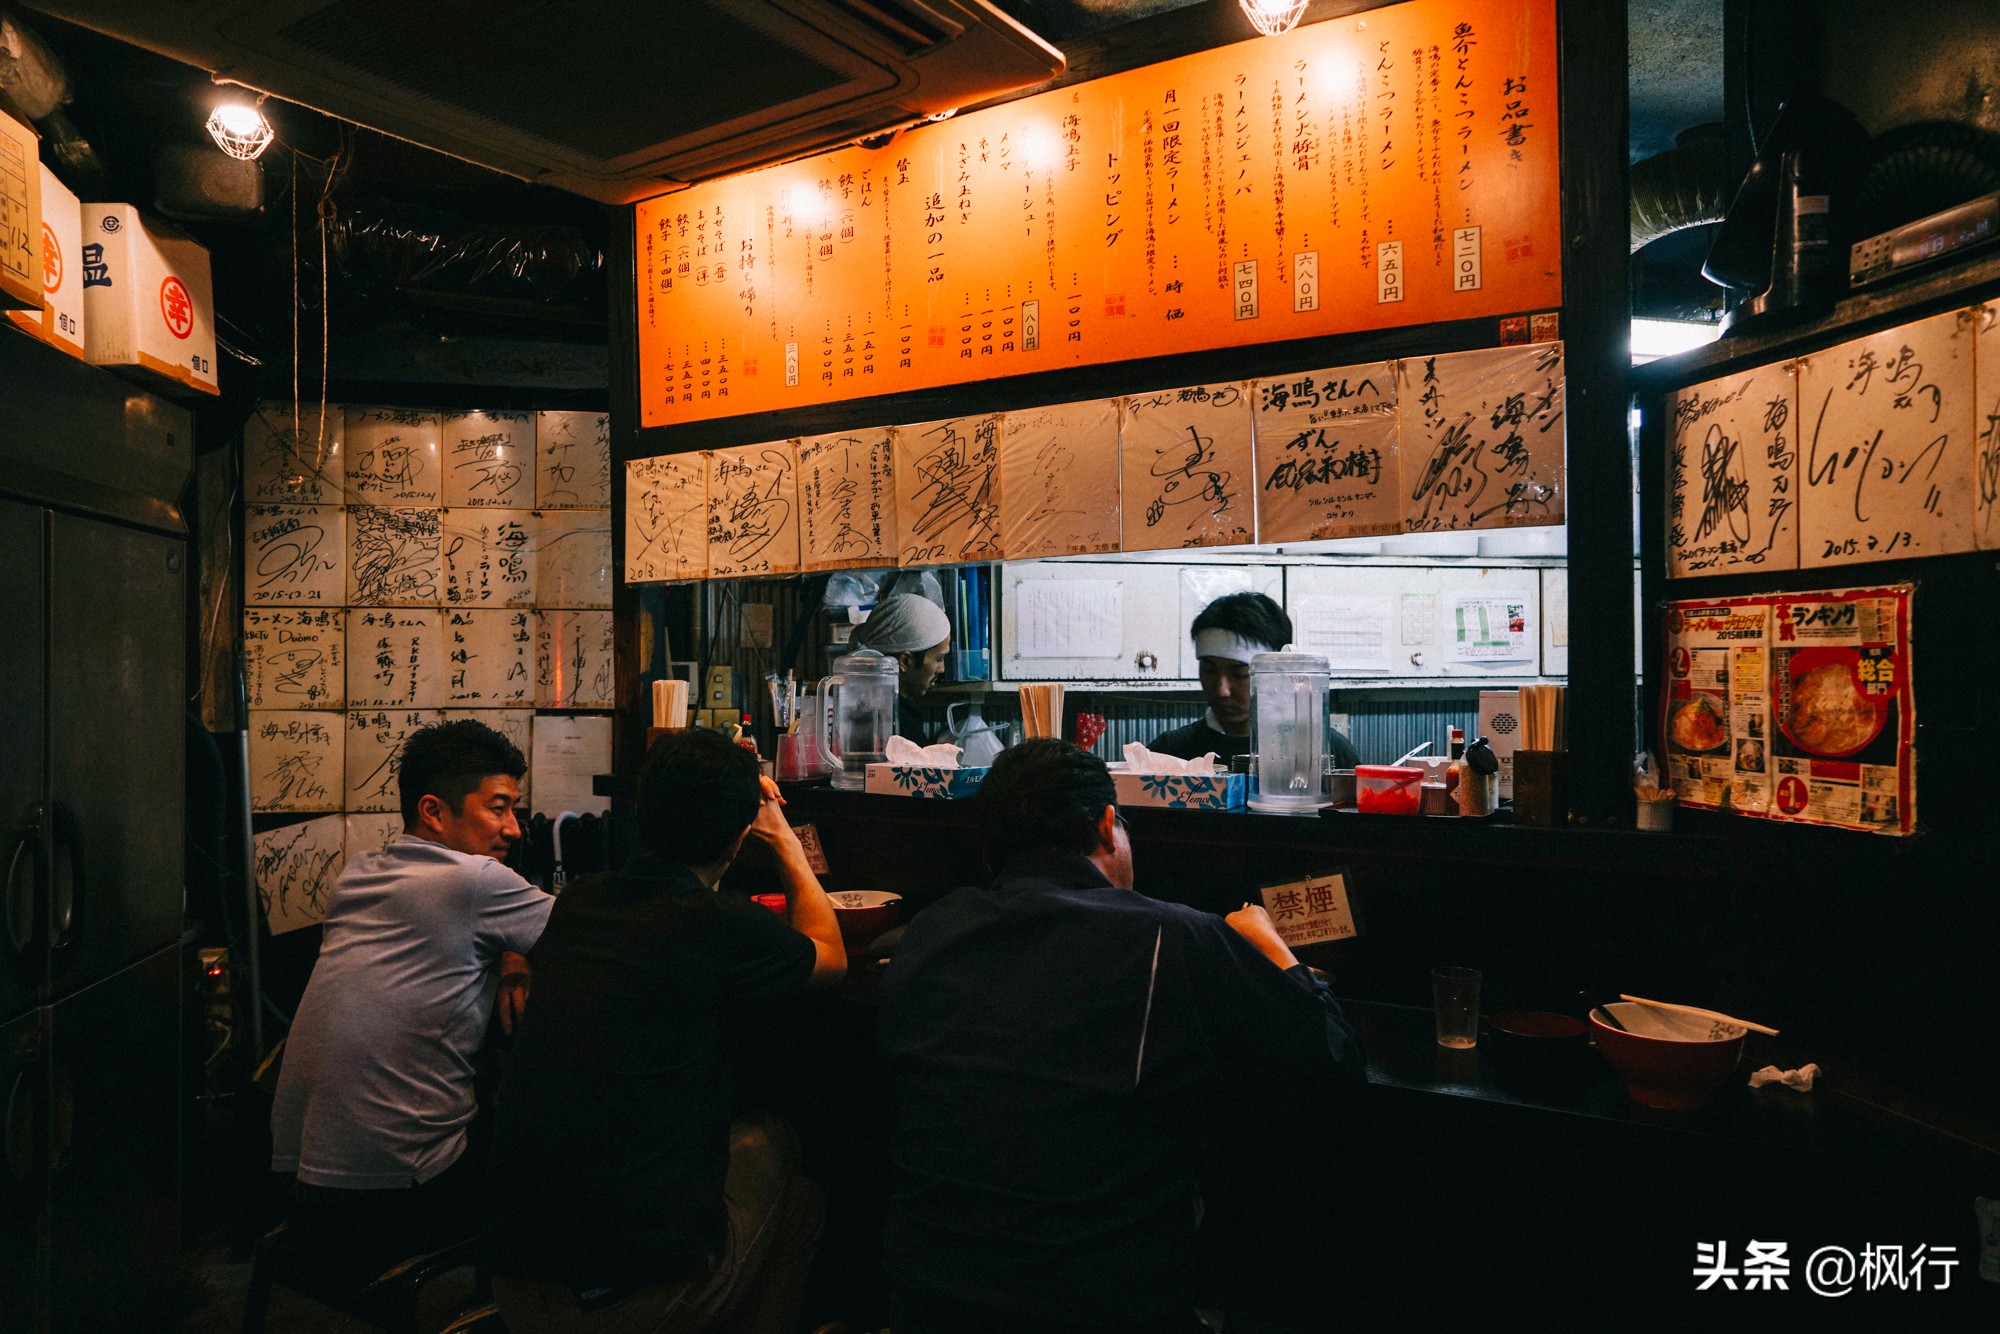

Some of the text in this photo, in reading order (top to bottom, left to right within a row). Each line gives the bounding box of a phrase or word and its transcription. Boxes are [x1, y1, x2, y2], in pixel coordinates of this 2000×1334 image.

[1062, 114, 1081, 172] 海鳴玉子
[1498, 75, 1534, 171] お品書き
[896, 157, 911, 185] 替玉
[978, 137, 990, 163] ネギ
[999, 132, 1011, 171] メンマ
[1163, 89, 1183, 225] 月一回限定ラーメン
[1377, 40, 1400, 299] とんこつラーメン 六五〇円
[1452, 22, 1478, 288] 魚介とんこつラーメン 七二〇円
[861, 168, 872, 208] ごはん
[958, 142, 972, 226] きざみ玉ねぎ
[1105, 153, 1124, 247] トッピング
[1234, 73, 1253, 317] ラーメンジェノバ 七四〇円
[1292, 59, 1314, 309] ラーメン火豚骨 六八〇円
[924, 192, 945, 283] 追加の一品
[739, 238, 757, 317] お持ち帰り
[59, 311, 76, 336] 個口
[165, 284, 190, 331] 幸
[191, 354, 208, 374] 個口
[1262, 377, 1380, 412] 海鳴さんへ
[1286, 429, 1340, 452] ずん
[496, 521, 529, 584] 海鳴
[1792, 604, 1856, 627] ランキング
[1857, 658, 1896, 683] 総合
[1866, 682, 1888, 696] 部門
[1271, 884, 1338, 922] 禁煙
